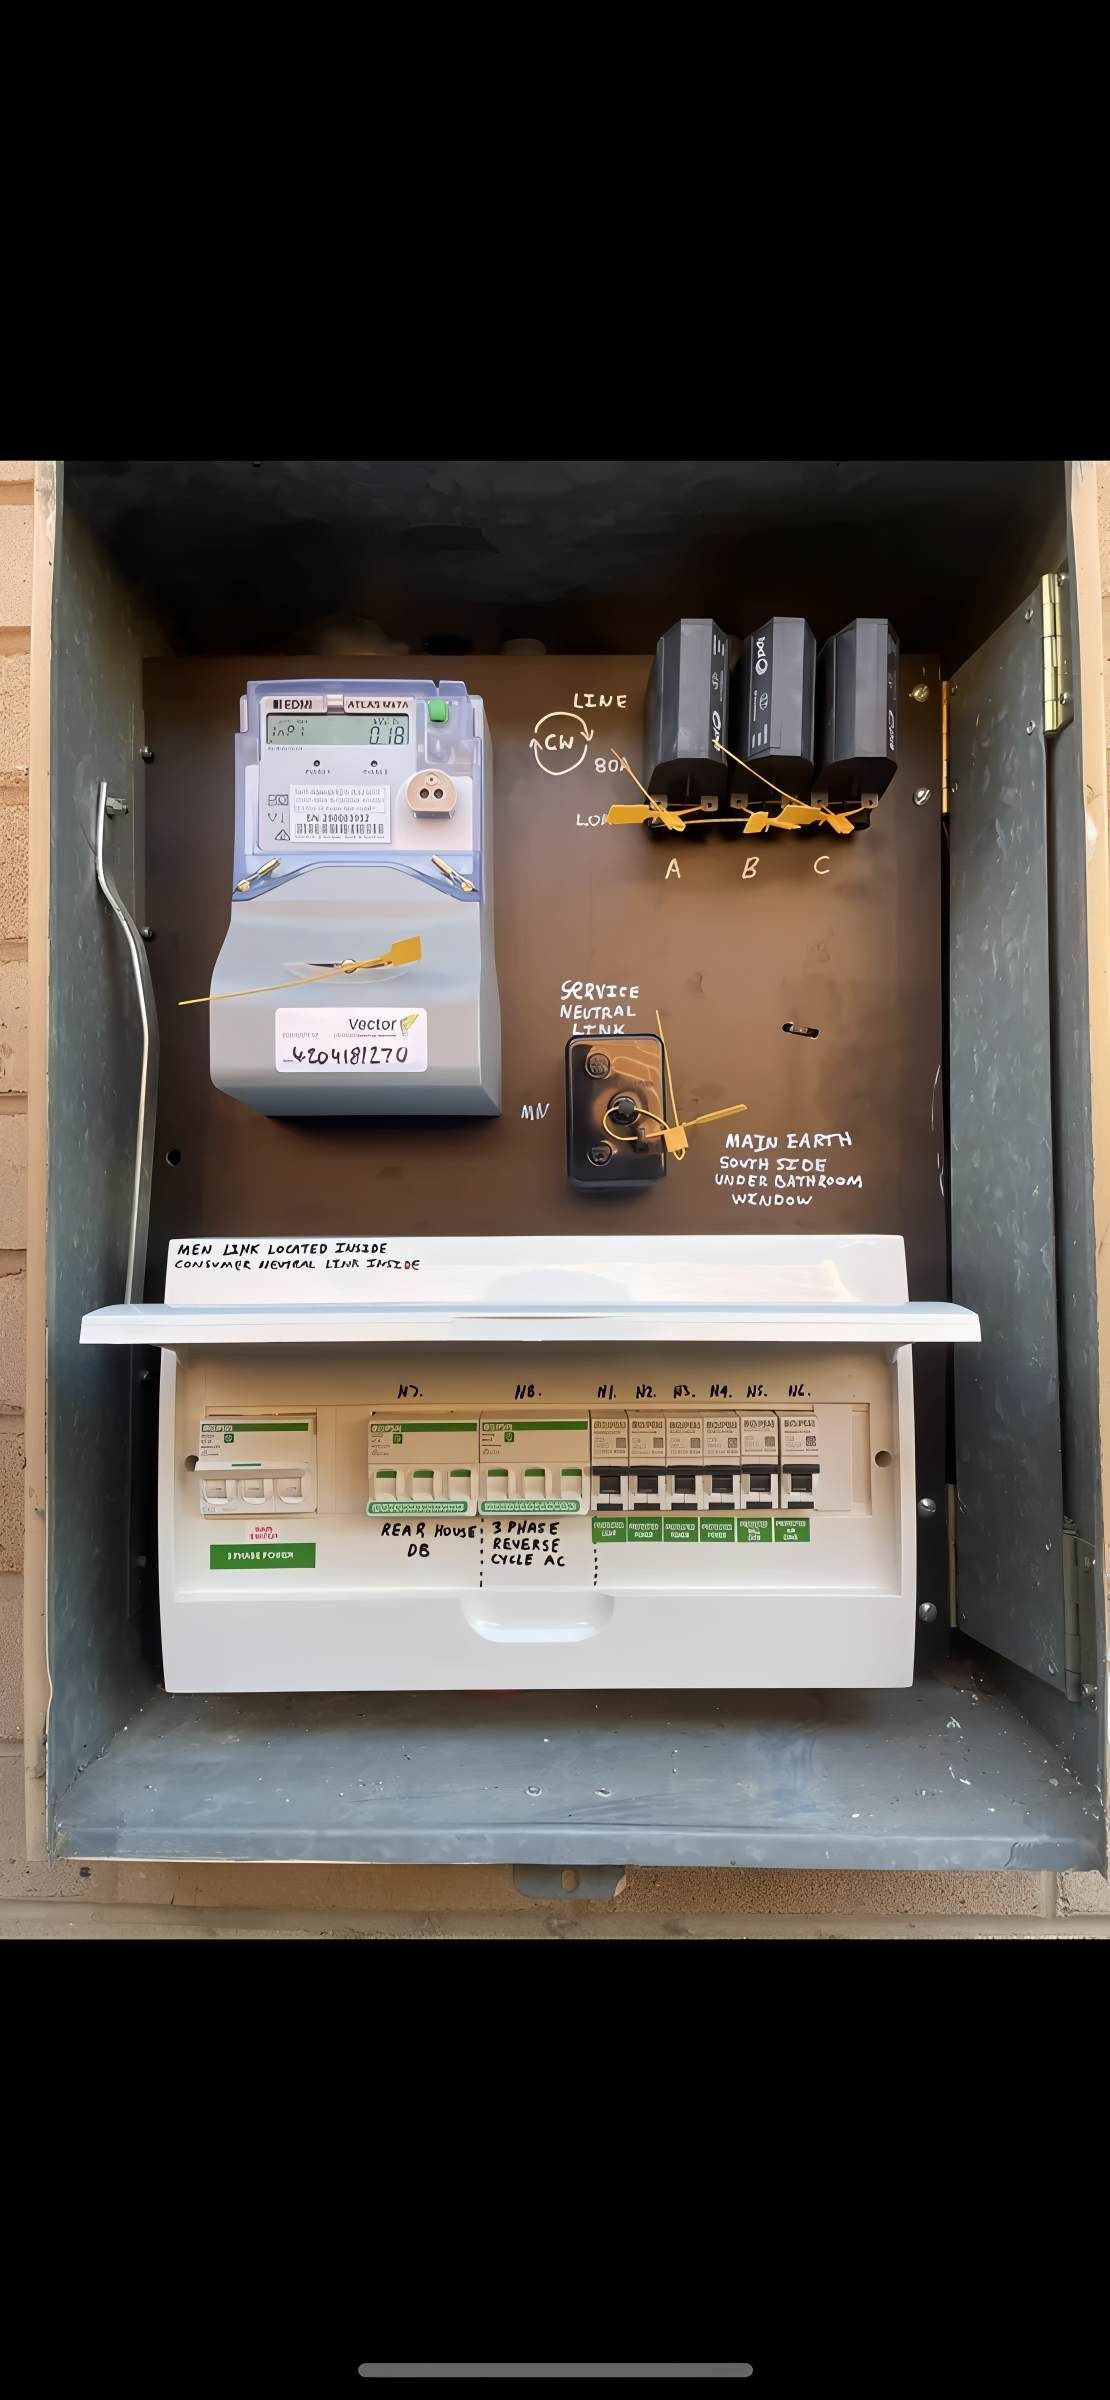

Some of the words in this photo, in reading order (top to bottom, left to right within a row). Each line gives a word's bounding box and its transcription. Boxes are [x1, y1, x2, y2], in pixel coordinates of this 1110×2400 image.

[573, 693, 627, 709] LINE
[545, 734, 574, 751] CW
[665, 857, 681, 879] A
[742, 857, 759, 879] B
[813, 856, 830, 875] C
[561, 979, 640, 1000] SERVICE
[559, 1004, 636, 1020] NEUTRAL
[349, 1018, 397, 1031] Vector
[572, 1023, 625, 1035] LINK
[292, 1046, 408, 1065] 4204181270
[520, 1102, 550, 1121] MN
[725, 1133, 778, 1153] MAIN
[787, 1131, 853, 1149] EARTH
[719, 1156, 769, 1171] SOUTH
[776, 1158, 827, 1172] SIDE
[715, 1174, 768, 1188] UNDER
[774, 1174, 864, 1188] BATHROOM
[731, 1192, 812, 1207] WINDOW
[177, 1243, 212, 1255] MEN
[223, 1243, 260, 1256] LINK
[268, 1243, 328, 1255] LOCATED
[335, 1242, 388, 1254] INSIDE
[174, 1259, 251, 1271] CONSUMER
[258, 1259, 316, 1270] NEUTRAL
[326, 1258, 360, 1269] LINK
[366, 1258, 421, 1271] INSIDE
[597, 1384, 616, 1399] N1.
[636, 1384, 656, 1399] N2.
[746, 1384, 767, 1398] N5.
[788, 1383, 811, 1398] N6.
[381, 1522, 426, 1538] REAR
[434, 1523, 477, 1538] HOUSE
[492, 1521, 501, 1535] 3
[507, 1521, 560, 1535] PHASE
[407, 1543, 430, 1557] DB
[493, 1538, 560, 1553] REVERSE
[490, 1553, 533, 1566] CYCLE
[544, 1555, 566, 1567] AC
